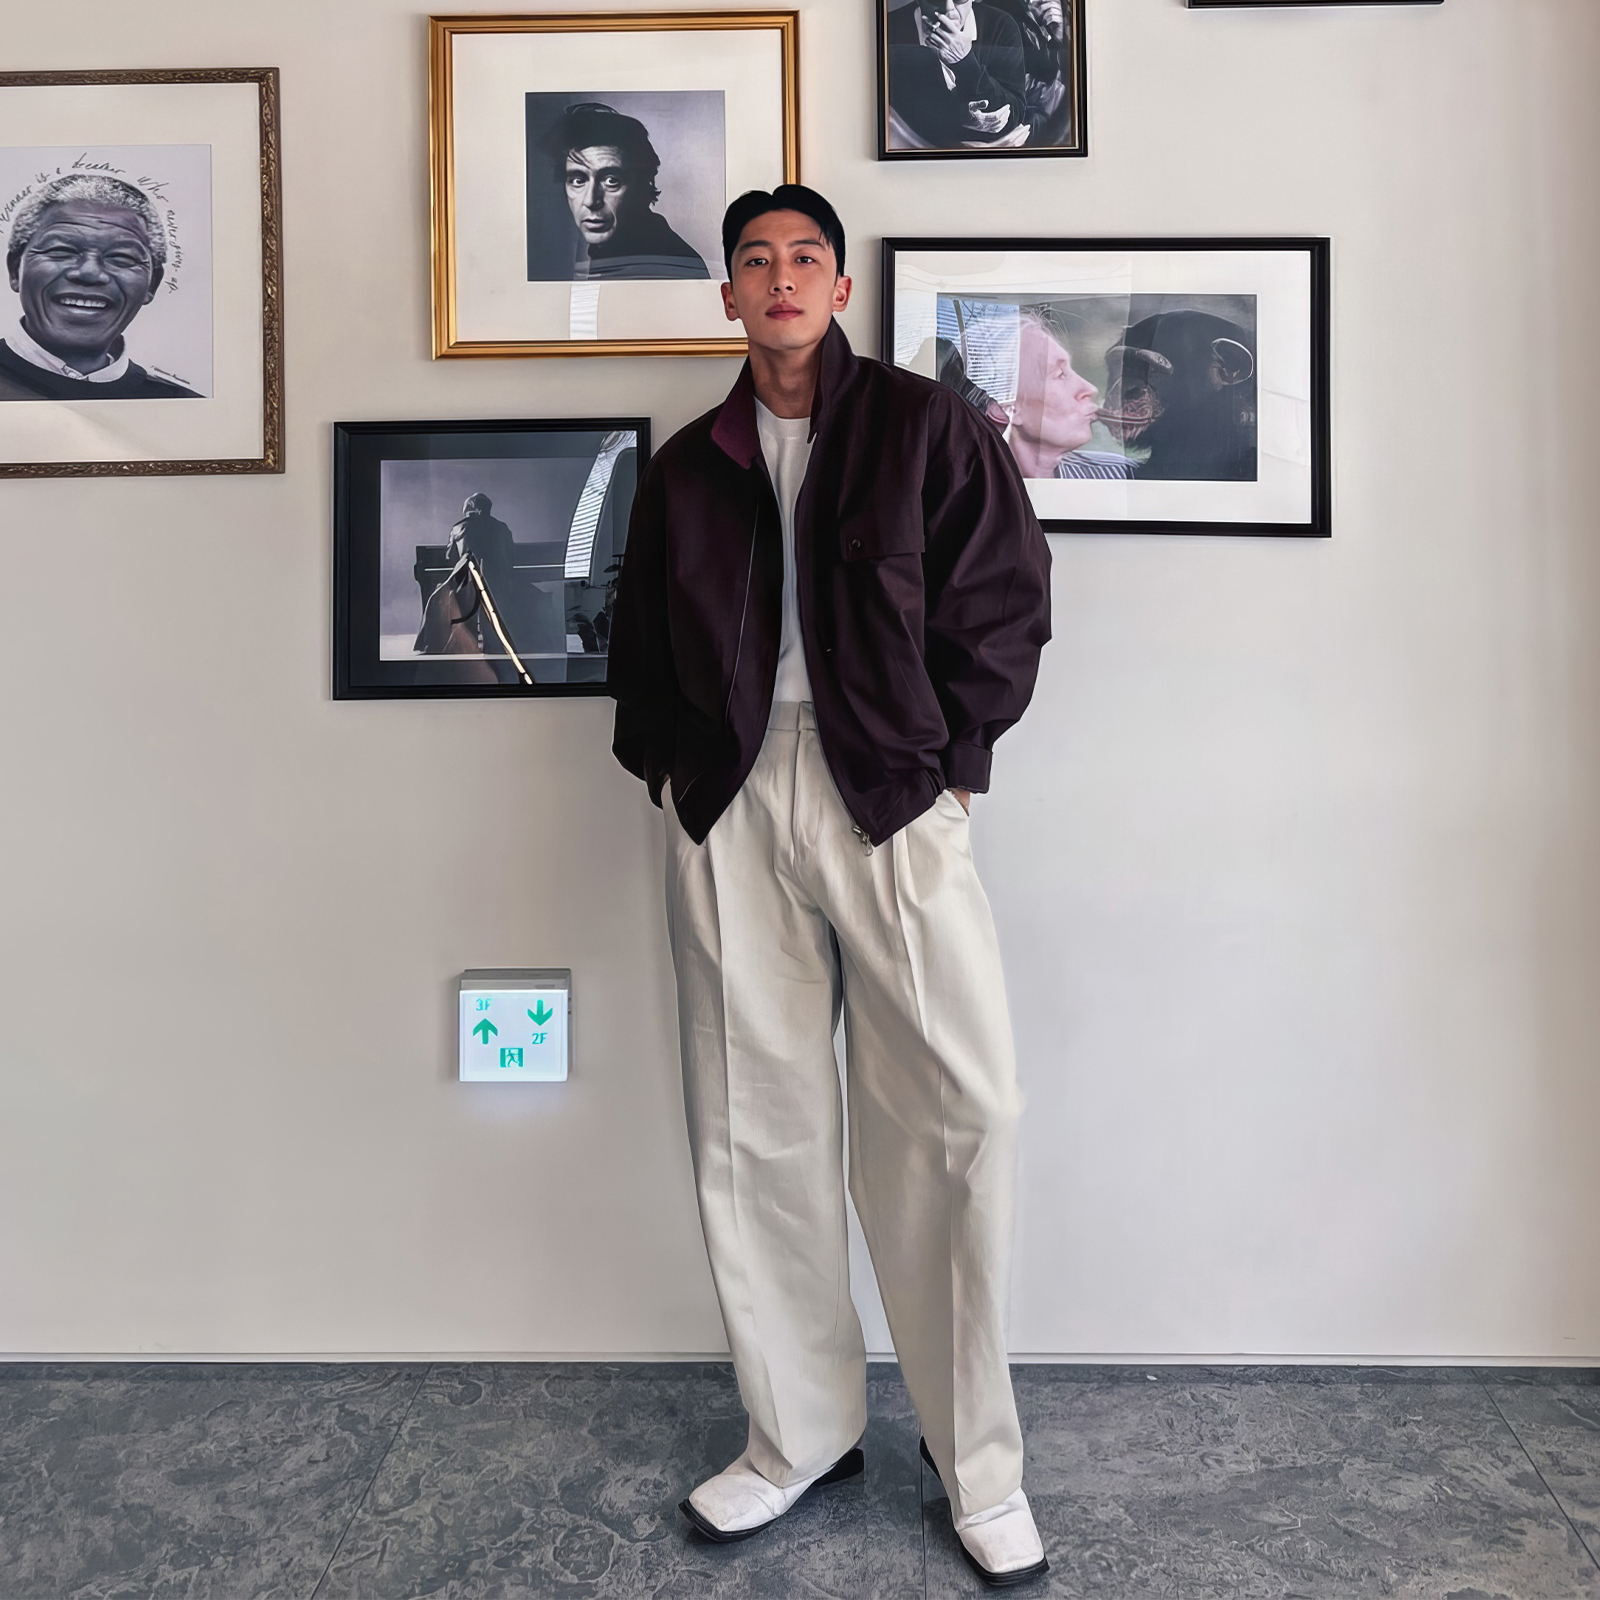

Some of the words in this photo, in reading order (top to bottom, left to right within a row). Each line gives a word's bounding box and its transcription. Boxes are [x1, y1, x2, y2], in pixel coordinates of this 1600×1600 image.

[35, 172, 51, 184] is
[137, 176, 169, 203] who
[475, 998, 492, 1011] 3F
[532, 1032, 548, 1045] 2F
